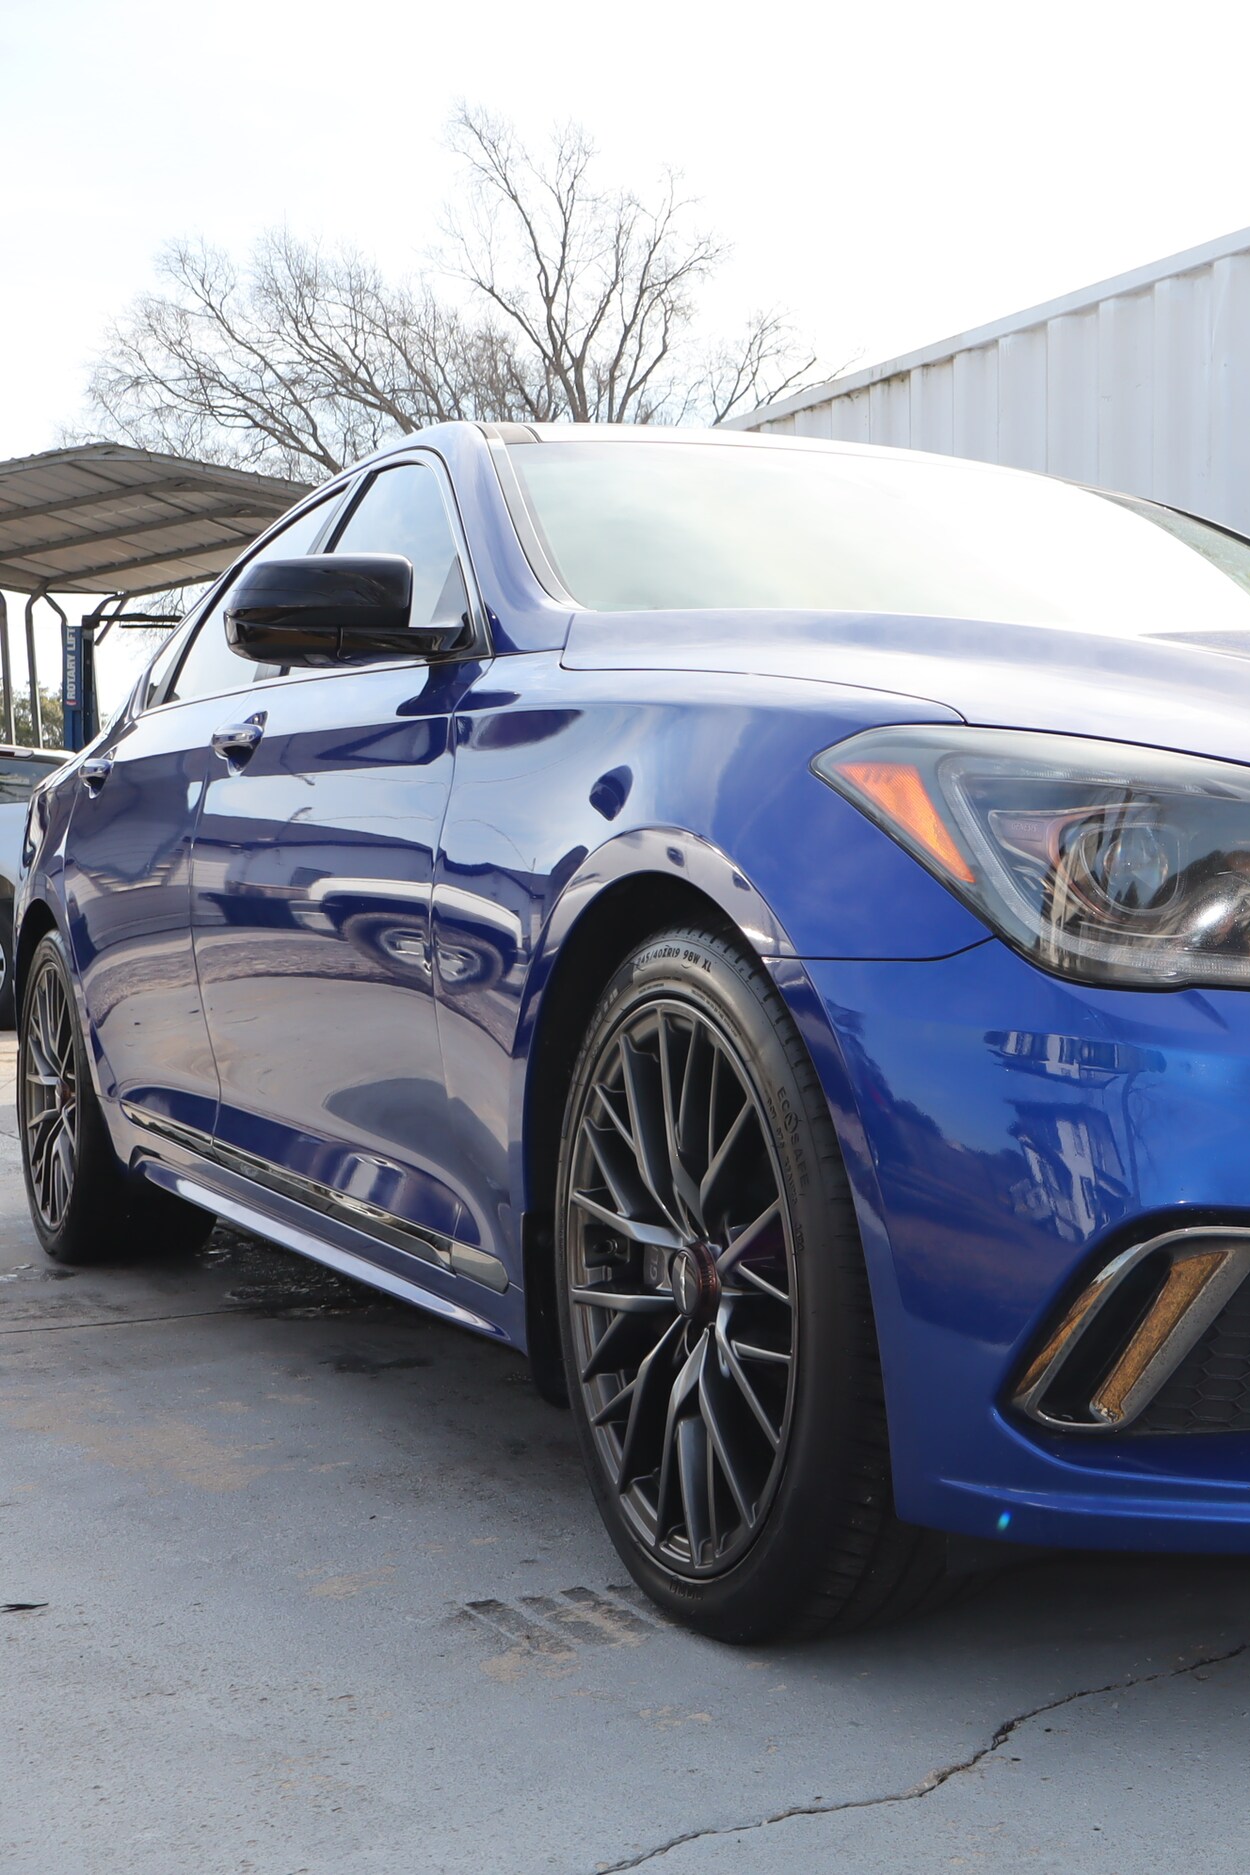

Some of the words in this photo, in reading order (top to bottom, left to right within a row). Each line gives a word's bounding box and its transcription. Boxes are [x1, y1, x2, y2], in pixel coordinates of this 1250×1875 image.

[66, 627, 76, 651] LIFT
[66, 655, 76, 700] ROTARY
[683, 949, 701, 965] 98W
[701, 958, 712, 974] XL
